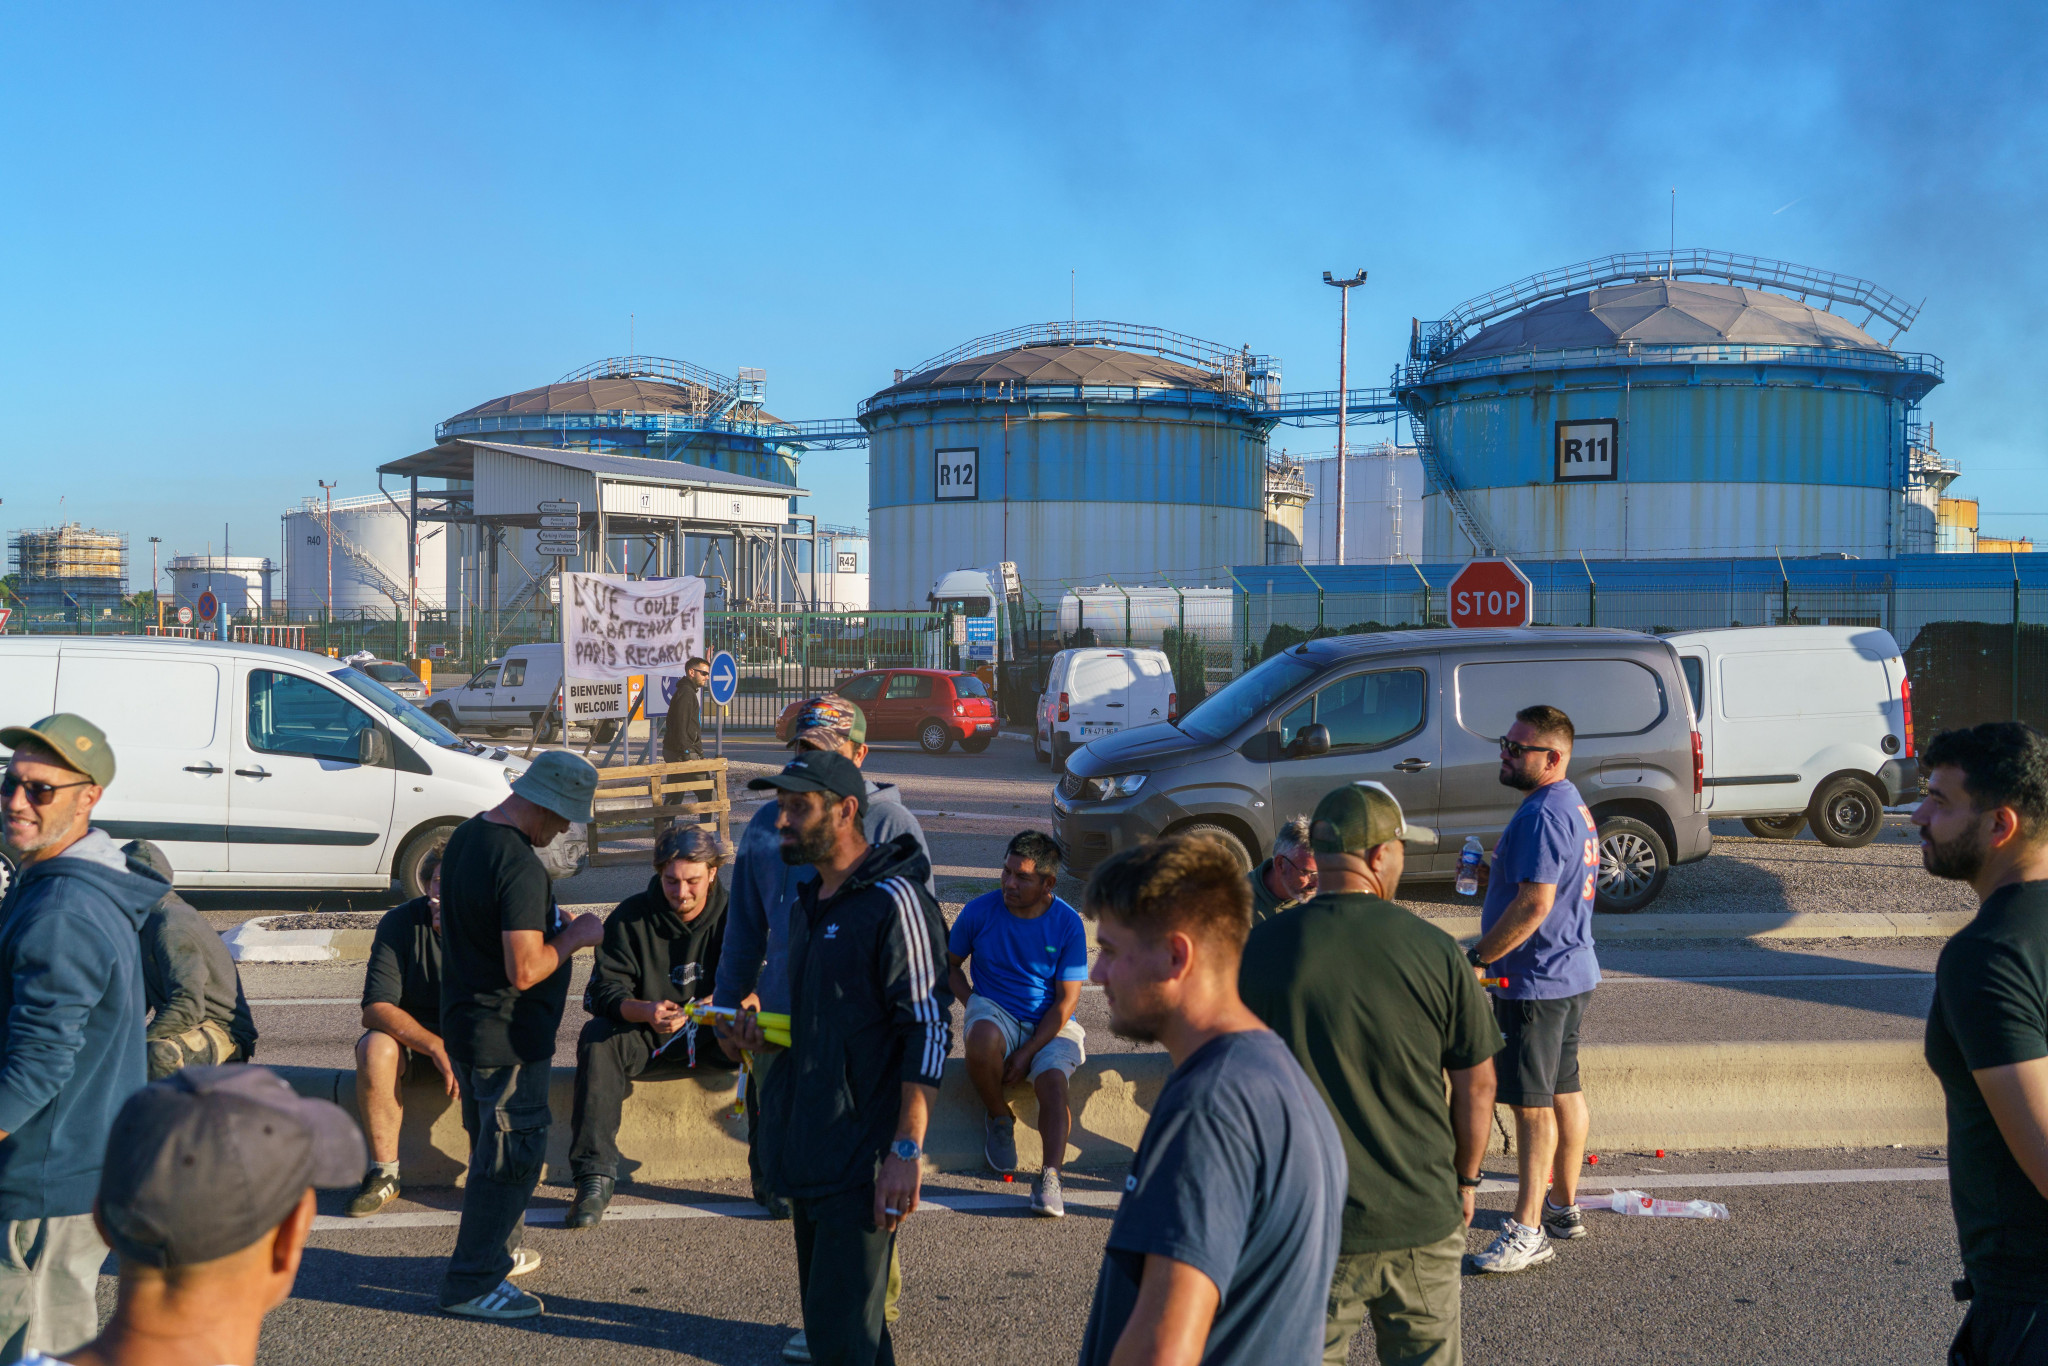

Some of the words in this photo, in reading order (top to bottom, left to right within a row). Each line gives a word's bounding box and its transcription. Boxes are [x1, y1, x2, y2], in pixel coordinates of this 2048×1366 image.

[1564, 437, 1608, 463] R11
[940, 463, 973, 485] R12
[641, 495, 649, 506] 17
[733, 503, 740, 513] 16
[307, 536, 321, 546] R40
[839, 556, 855, 567] R42
[633, 595, 680, 617] COULE
[1456, 590, 1520, 616] STOP
[606, 617, 677, 640] BATEAUX
[680, 607, 700, 631] ET
[624, 637, 696, 667] REGARDE
[570, 683, 623, 698] BIENVENUE
[574, 700, 619, 714] WELCOME
